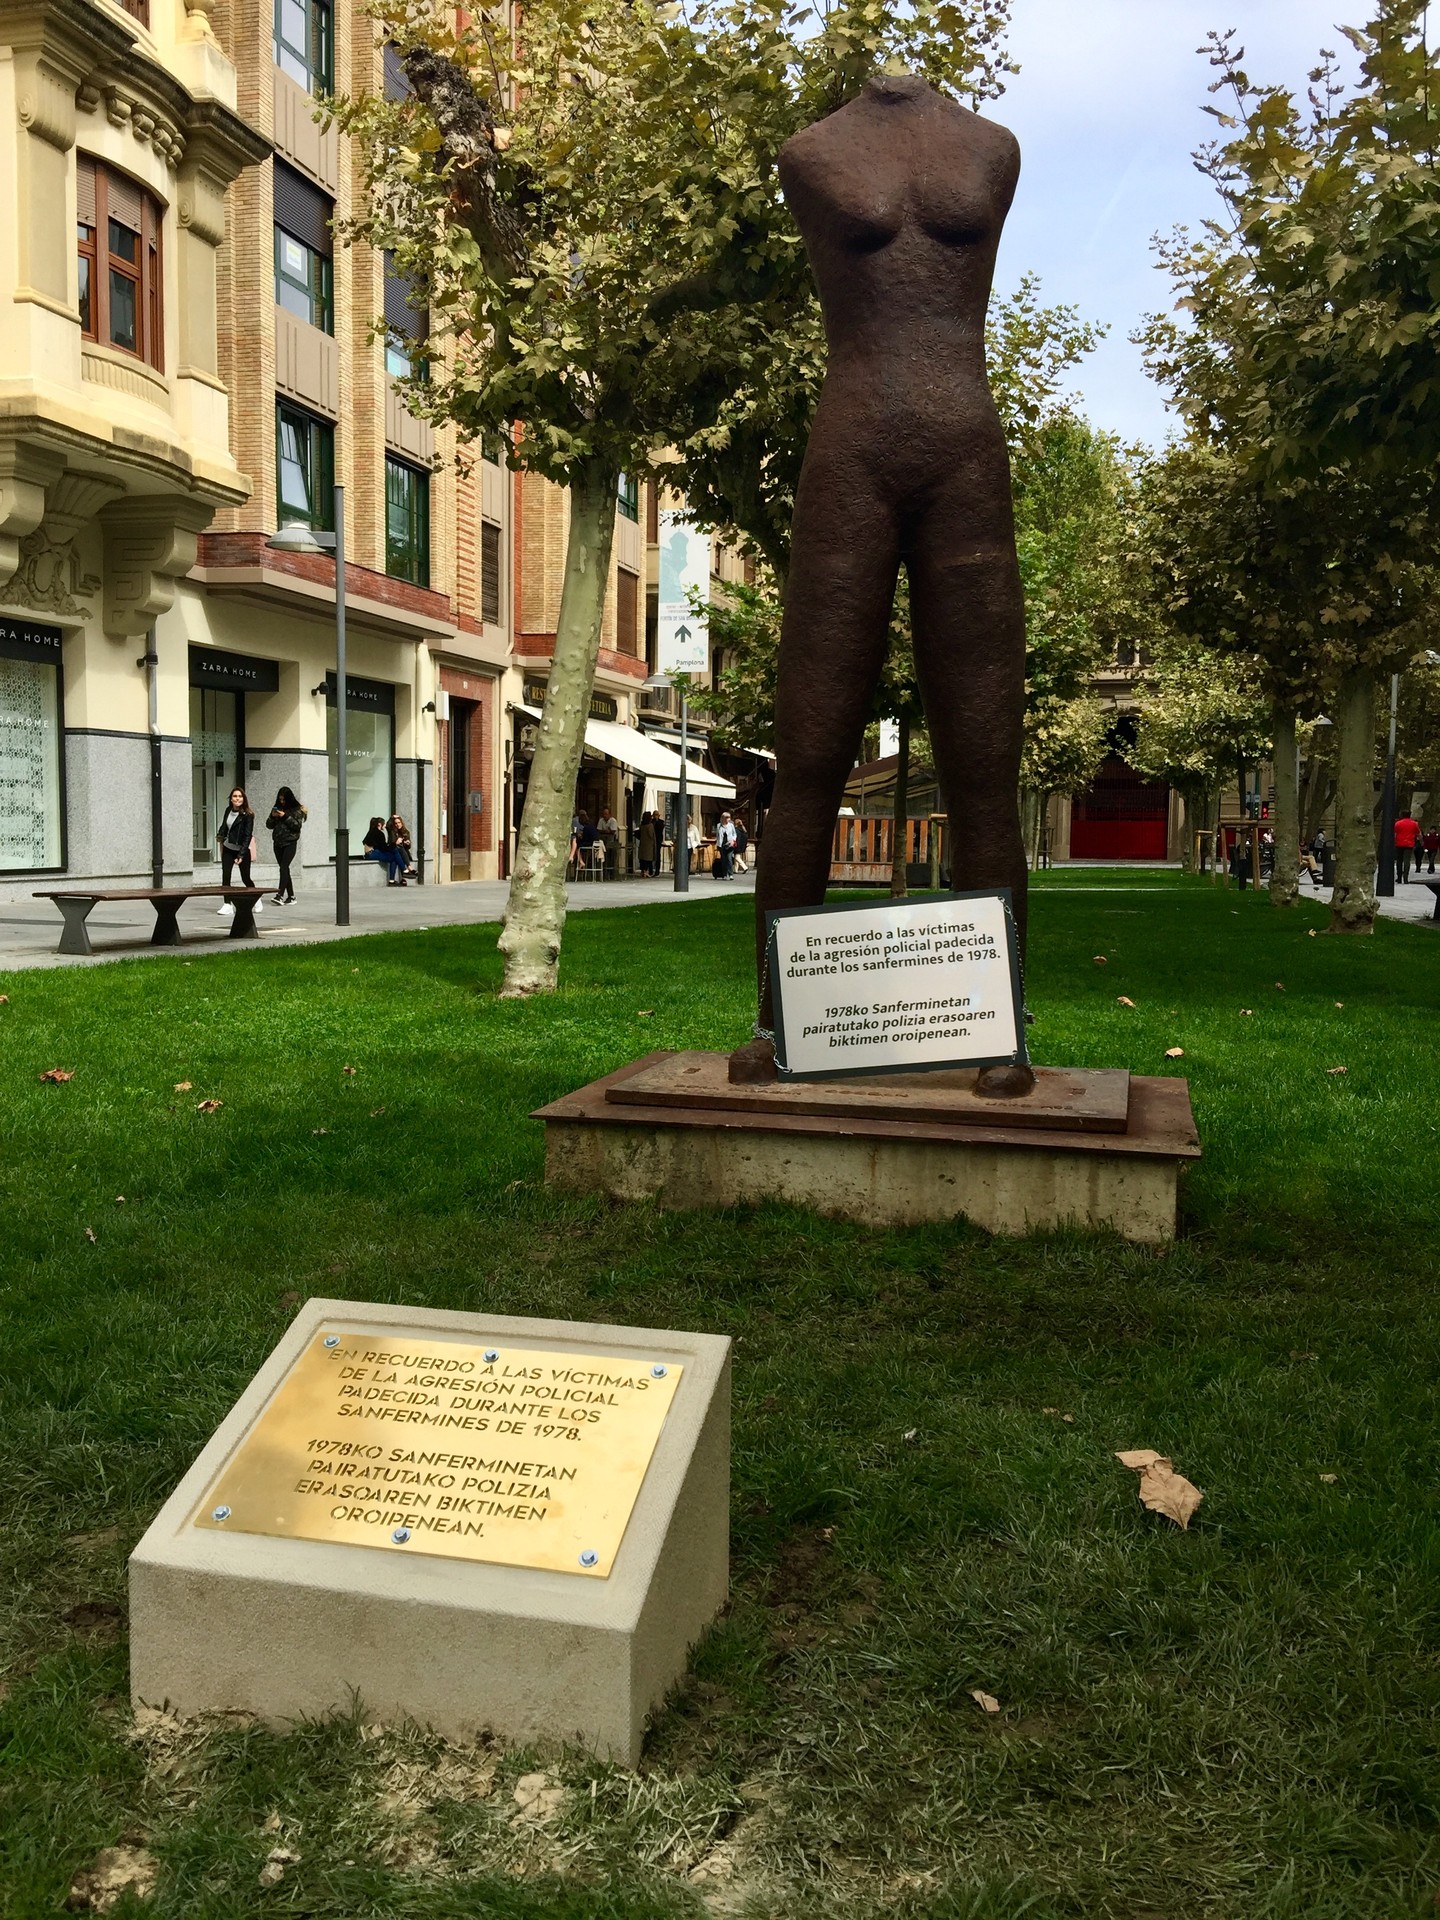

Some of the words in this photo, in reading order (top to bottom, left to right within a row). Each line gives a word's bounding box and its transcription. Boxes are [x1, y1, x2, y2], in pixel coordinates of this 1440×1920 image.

[0, 629, 17, 640] RA
[24, 633, 60, 647] HOME
[202, 662, 228, 674] ZARA
[232, 668, 256, 679] HOME
[359, 692, 377, 700] HOME
[0, 715, 12, 724] RA
[18, 718, 50, 728] HOME
[790, 952, 806, 963] de
[809, 950, 820, 962] la
[824, 946, 880, 963] agresión
[884, 939, 931, 958] policial
[934, 934, 994, 953] padecida
[806, 936, 822, 947] En
[825, 930, 882, 945] recuerdo
[886, 930, 894, 940] a
[897, 927, 915, 938] las
[918, 922, 975, 936] víctimas
[786, 962, 837, 978] durante
[841, 960, 859, 973] los
[862, 954, 944, 971] sanfermines
[947, 951, 964, 963] de
[968, 948, 1001, 961] 1978.
[824, 1005, 868, 1018] 1978ko
[872, 997, 971, 1014] Sanferminetan
[802, 1018, 879, 1038] pairatutako
[882, 1014, 926, 1031] polizia
[929, 1010, 995, 1024] erasoaren
[829, 1034, 888, 1048] biktimen
[892, 1026, 971, 1043] oroipenean.
[328, 1349, 358, 1361] EN
[361, 1352, 475, 1373] RECUERDO
[480, 1364, 495, 1376] A
[502, 1365, 543, 1380] LAS
[552, 1368, 650, 1390] VÍCTIMAS
[338, 1366, 369, 1380] DE
[371, 1370, 398, 1384] LA
[404, 1374, 516, 1395] AGRESIÓN
[520, 1384, 620, 1406] POLICIAL
[338, 1384, 440, 1407] PADECIDA
[450, 1397, 553, 1418] DURANTE
[558, 1407, 602, 1423] LOS
[337, 1404, 490, 1431] SANFERMINES
[496, 1420, 527, 1435] DE
[533, 1424, 582, 1441] 1978.
[307, 1439, 383, 1459] 1978KO
[388, 1448, 578, 1481] SANFERMINETAN
[306, 1459, 456, 1488] PAIRATUTAKO
[462, 1477, 551, 1500] POLIZIA
[294, 1479, 432, 1508] ERASOAREN
[436, 1496, 547, 1522] BIKTIMEN
[330, 1505, 484, 1538] OROIPENEAN.
